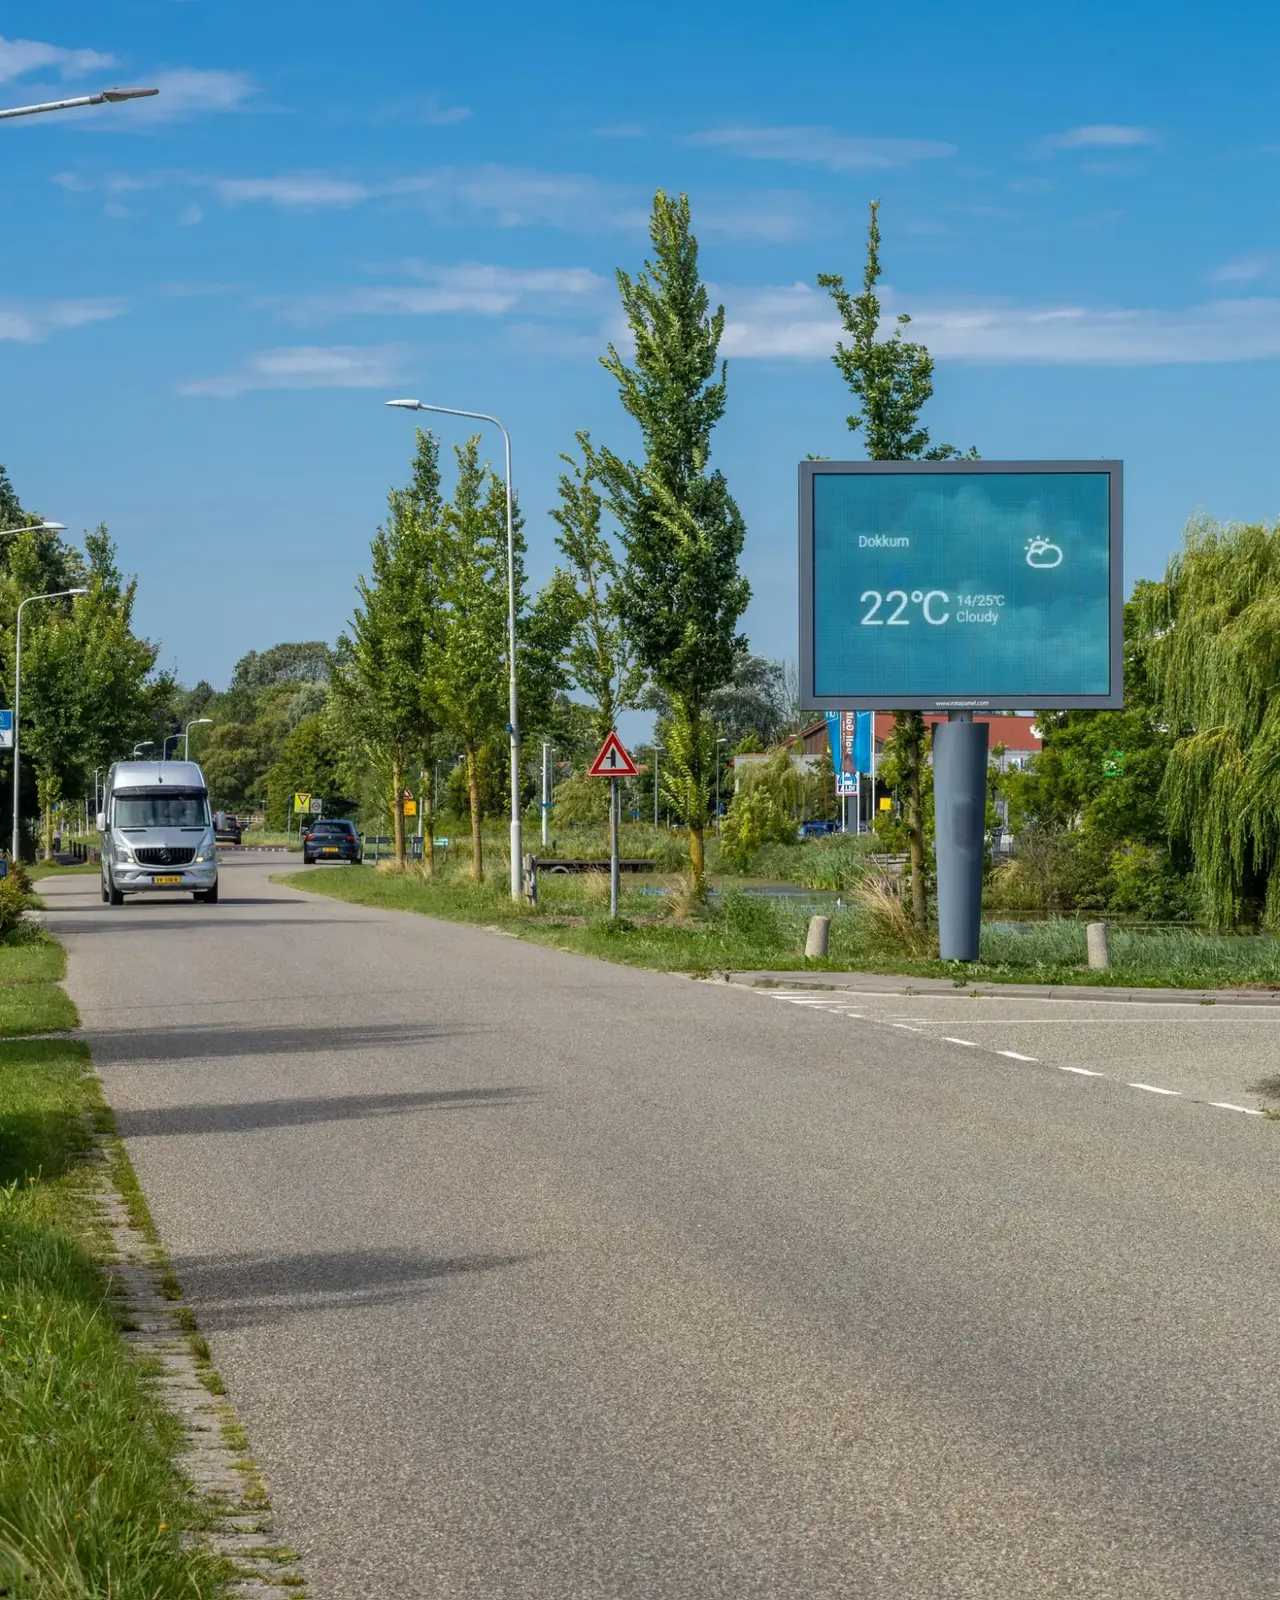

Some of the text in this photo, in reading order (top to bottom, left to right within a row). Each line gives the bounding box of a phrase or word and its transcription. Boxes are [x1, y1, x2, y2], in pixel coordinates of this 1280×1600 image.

[859, 535, 909, 548] Dokkum
[860, 590, 950, 625] 22°C
[956, 609, 999, 625] Cloudy
